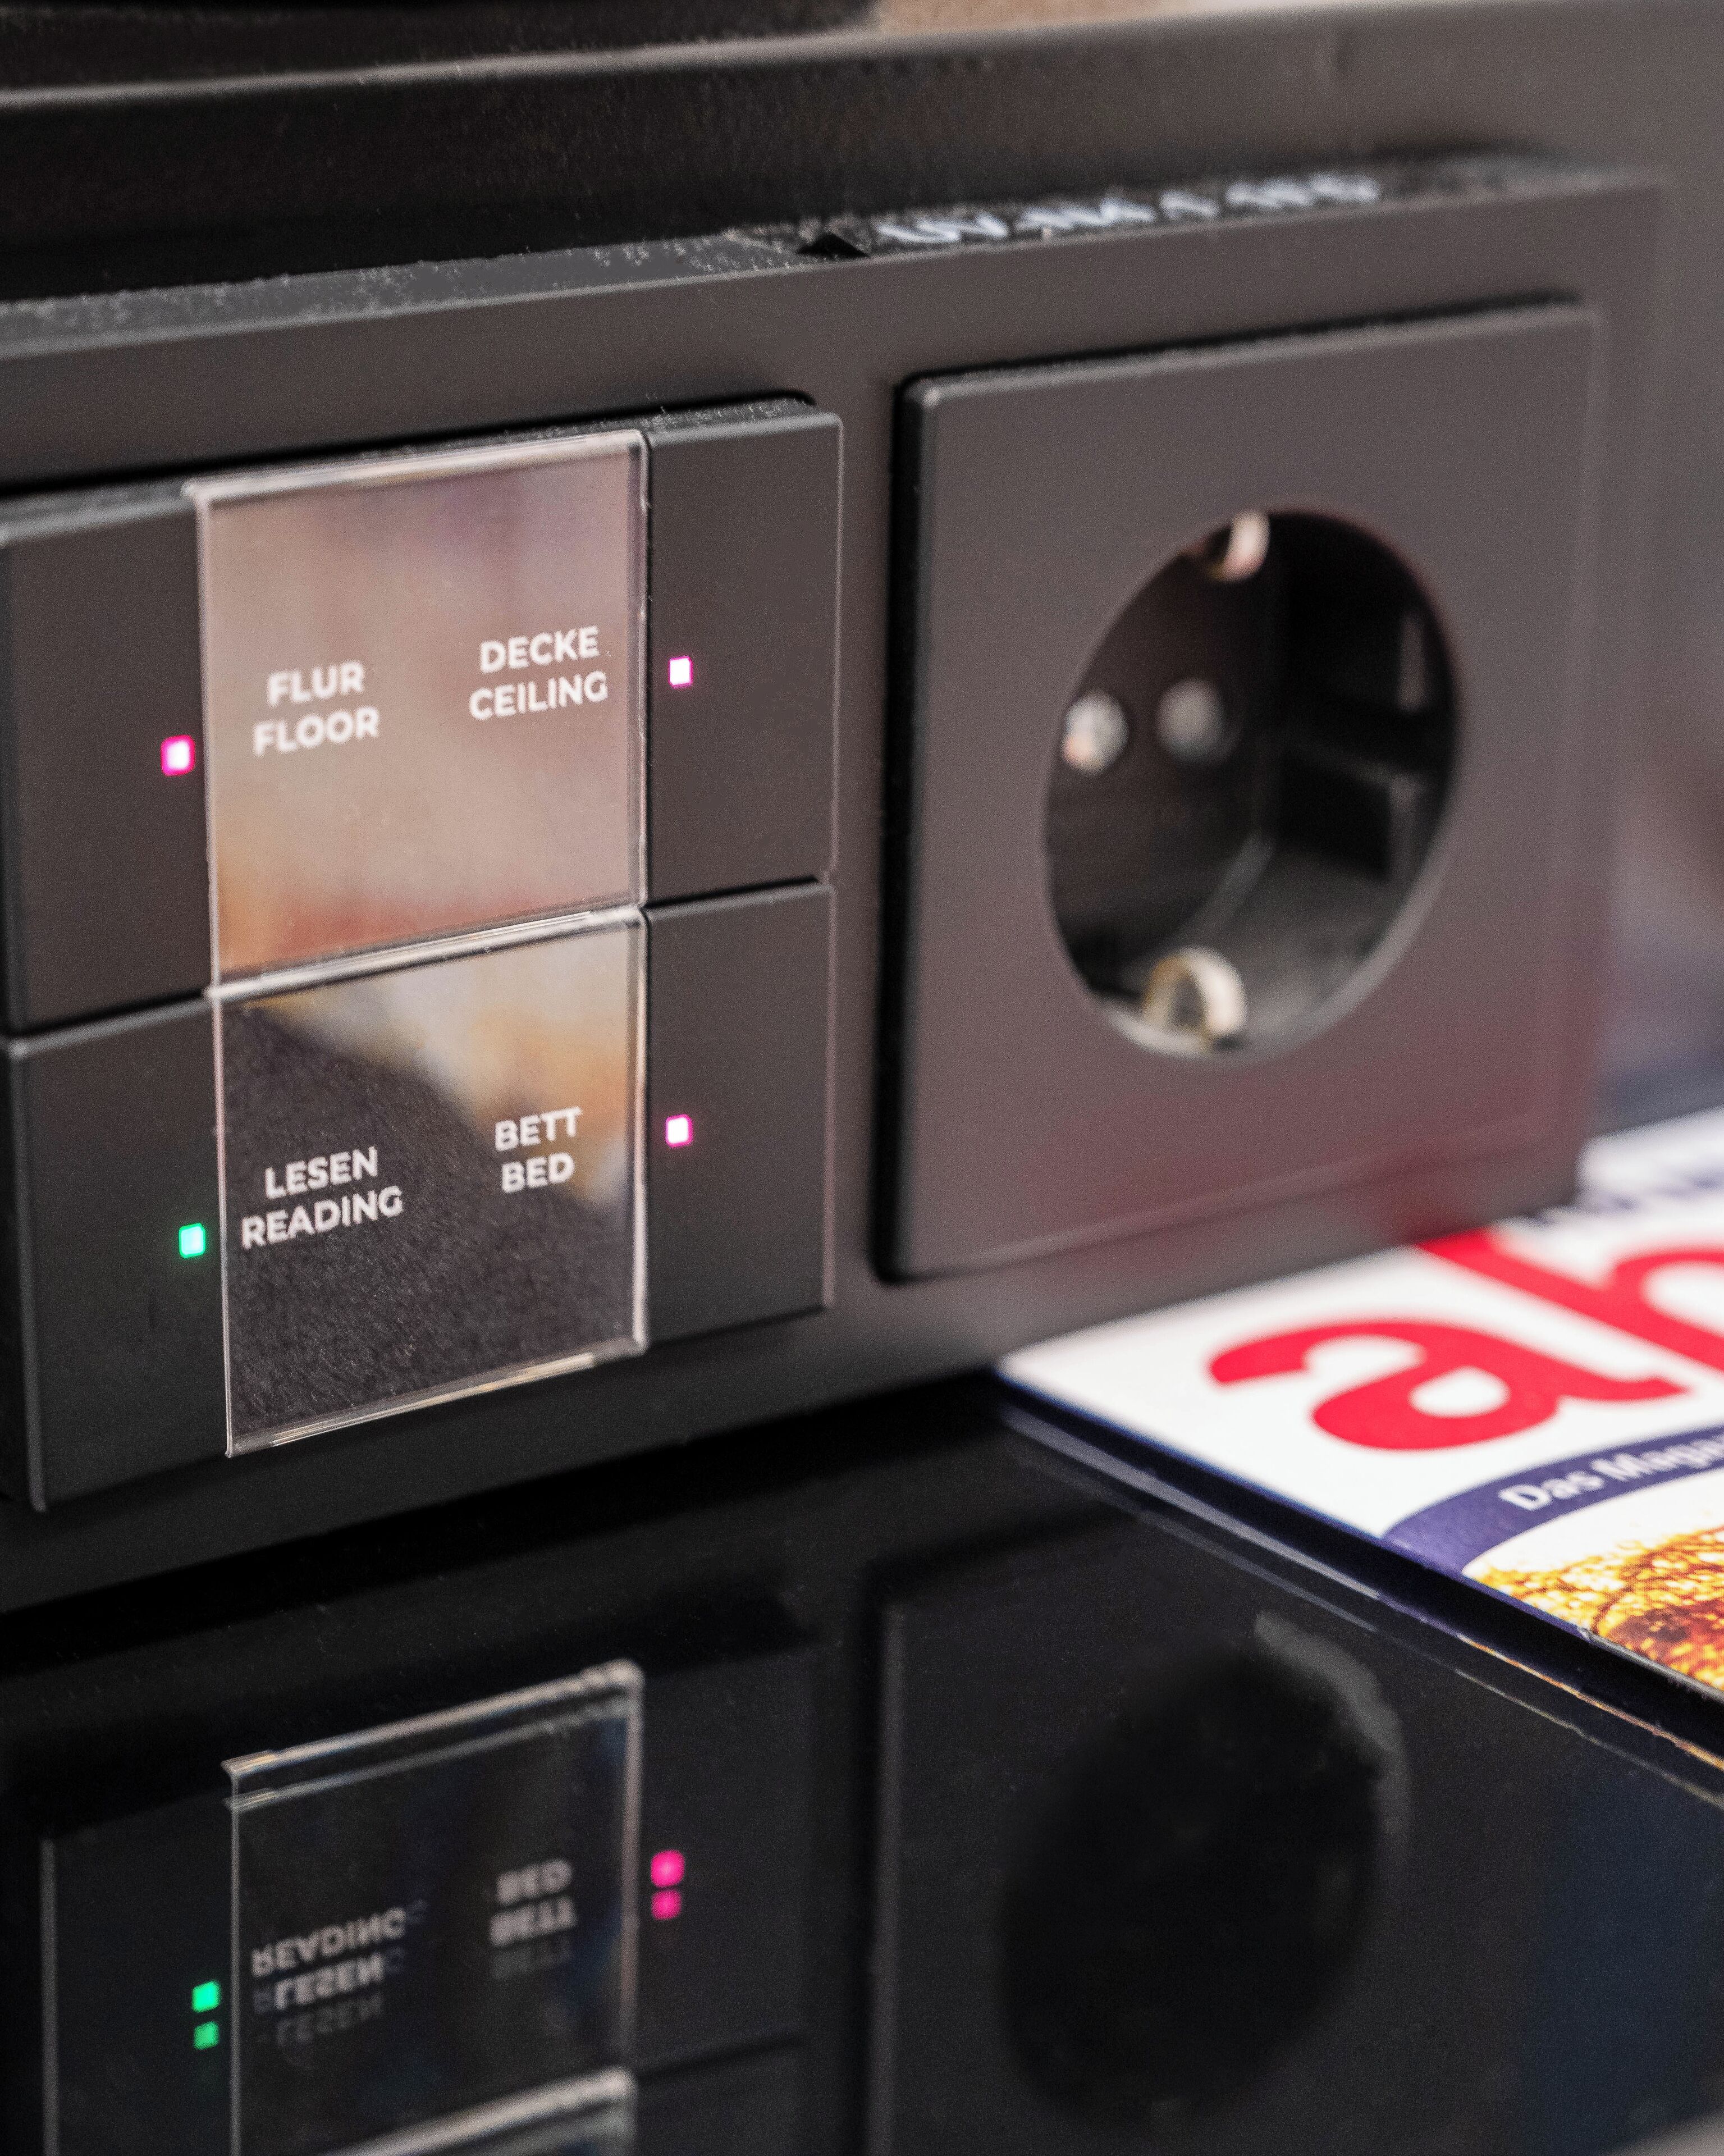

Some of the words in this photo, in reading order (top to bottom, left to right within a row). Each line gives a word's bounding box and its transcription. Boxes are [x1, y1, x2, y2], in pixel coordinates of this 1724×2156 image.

[480, 625, 600, 673] DECKE
[267, 660, 365, 707] FLUR
[469, 670, 609, 720] CEILING
[253, 706, 380, 756] FLOOR
[495, 1106, 582, 1152] BETT
[264, 1146, 379, 1199] LESEN
[501, 1152, 575, 1194] BED
[241, 1186, 404, 1249] READING
[1498, 1470, 1604, 1511] Das
[1592, 1435, 1724, 1482] Maga
